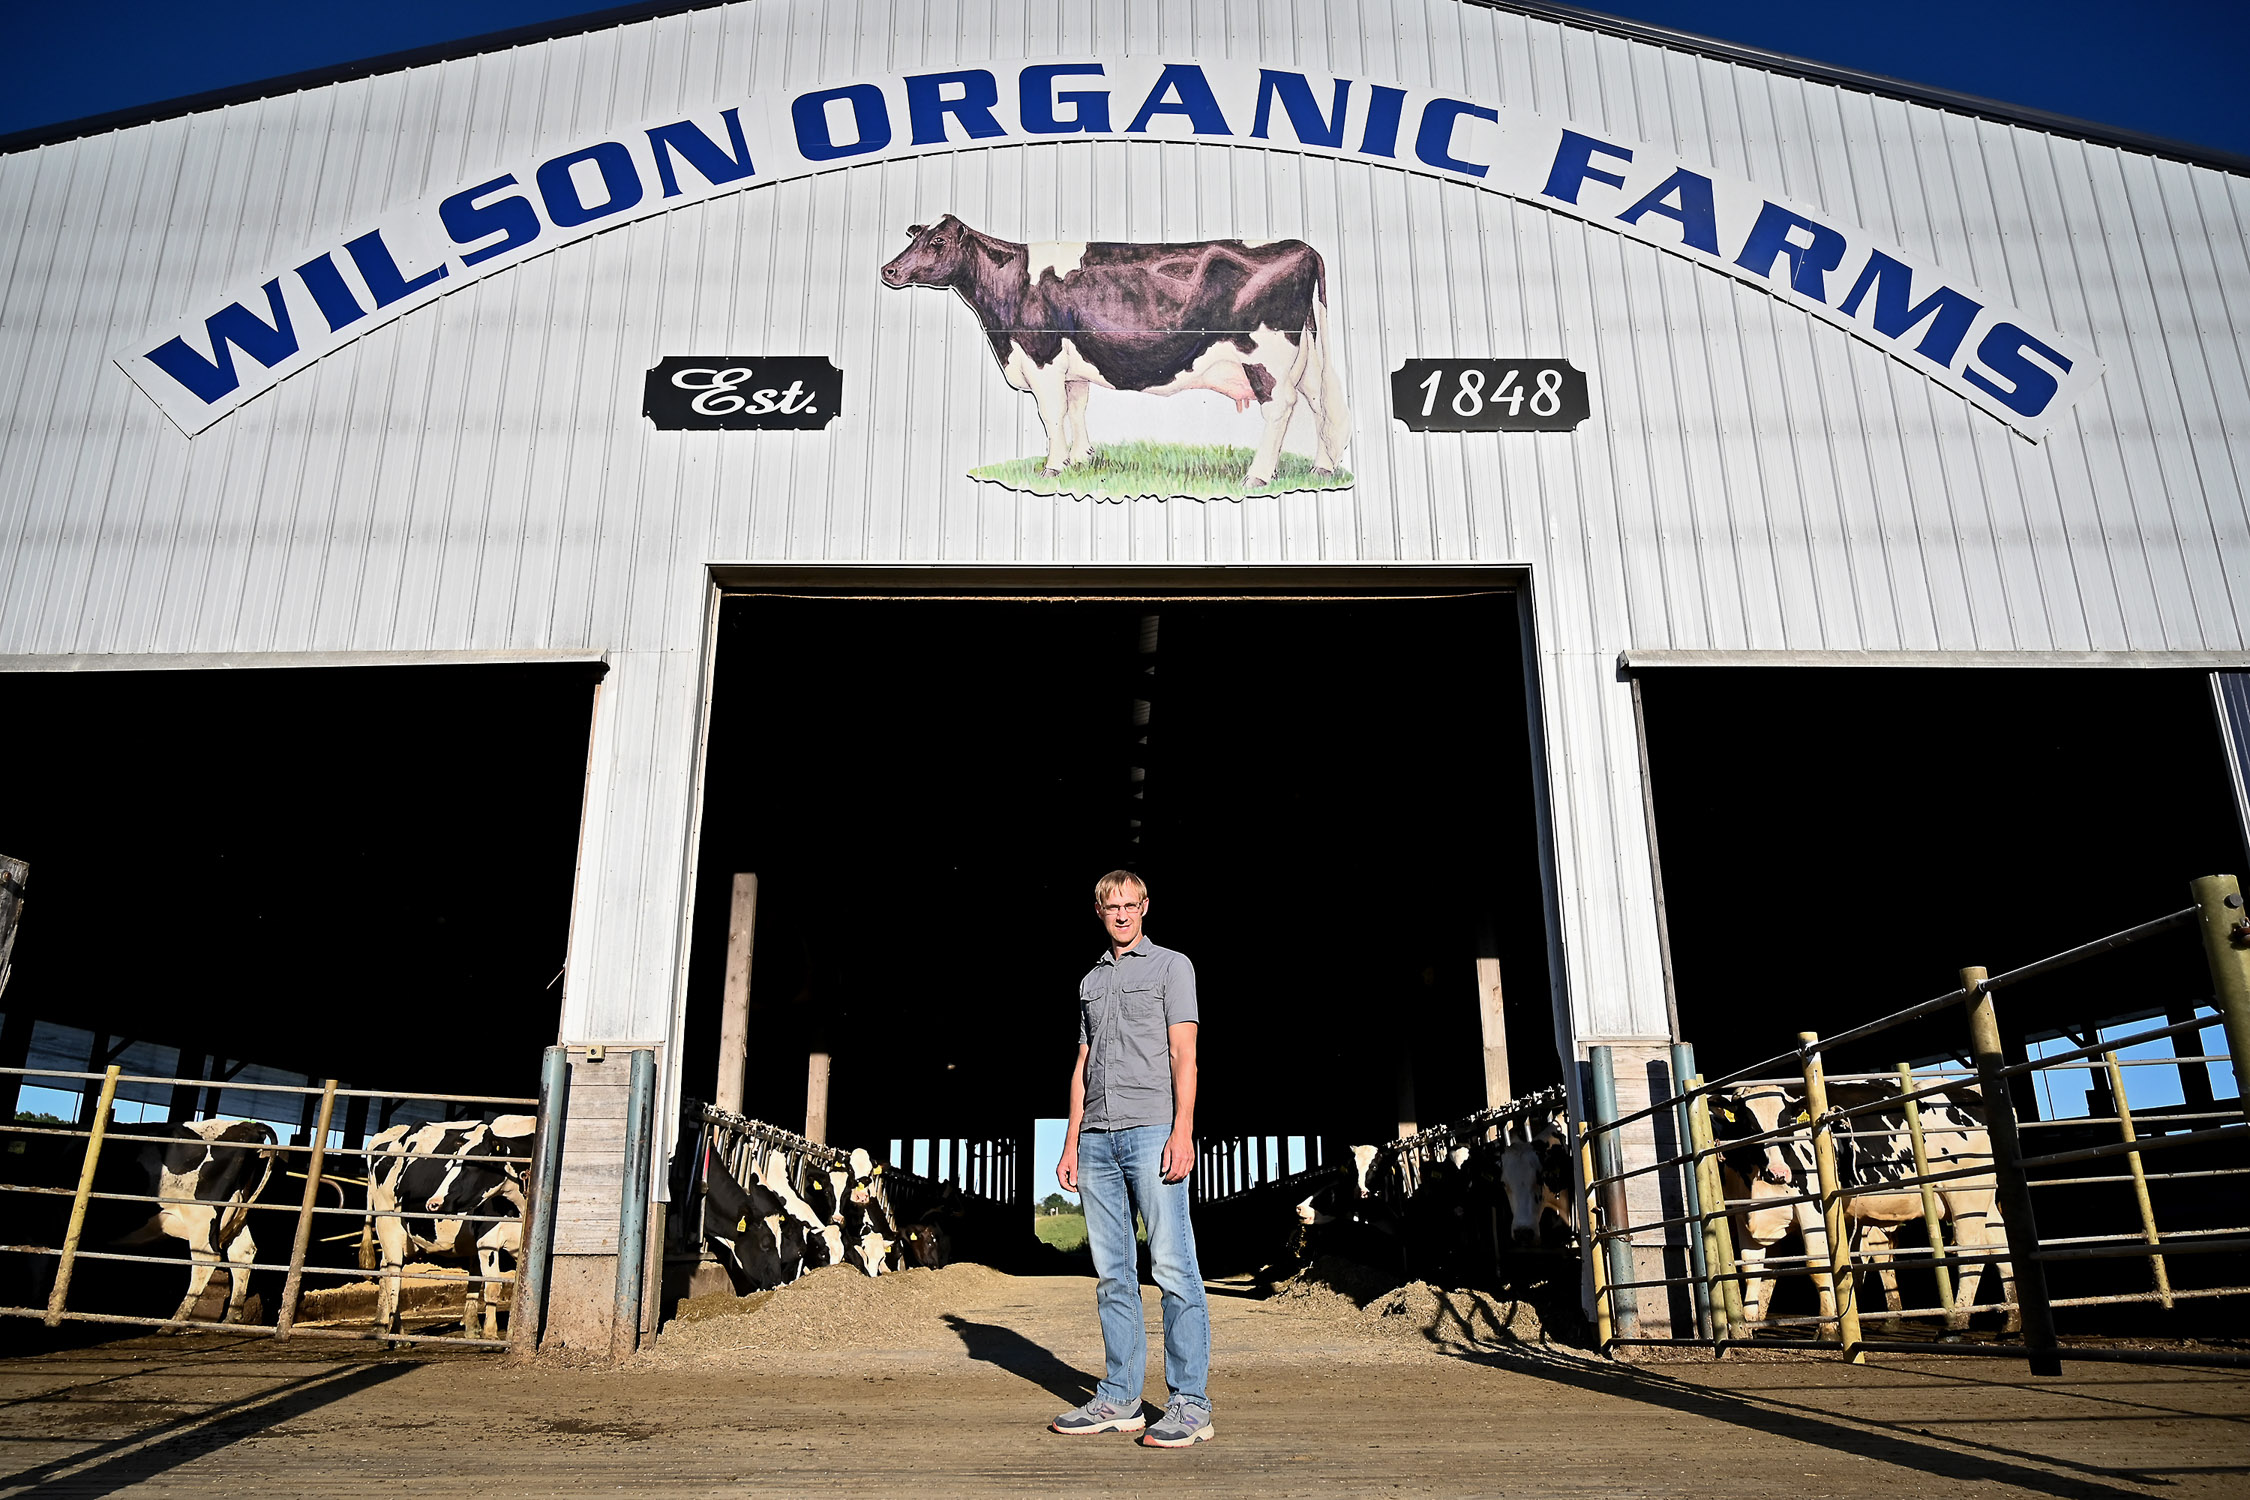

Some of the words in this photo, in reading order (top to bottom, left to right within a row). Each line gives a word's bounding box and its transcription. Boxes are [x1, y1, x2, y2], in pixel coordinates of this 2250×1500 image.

[145, 107, 756, 403] WILSON
[791, 63, 1499, 178] ORGANIC
[1541, 129, 2073, 417] FARMS
[671, 367, 818, 416] Est.
[1419, 369, 1563, 417] 1848
